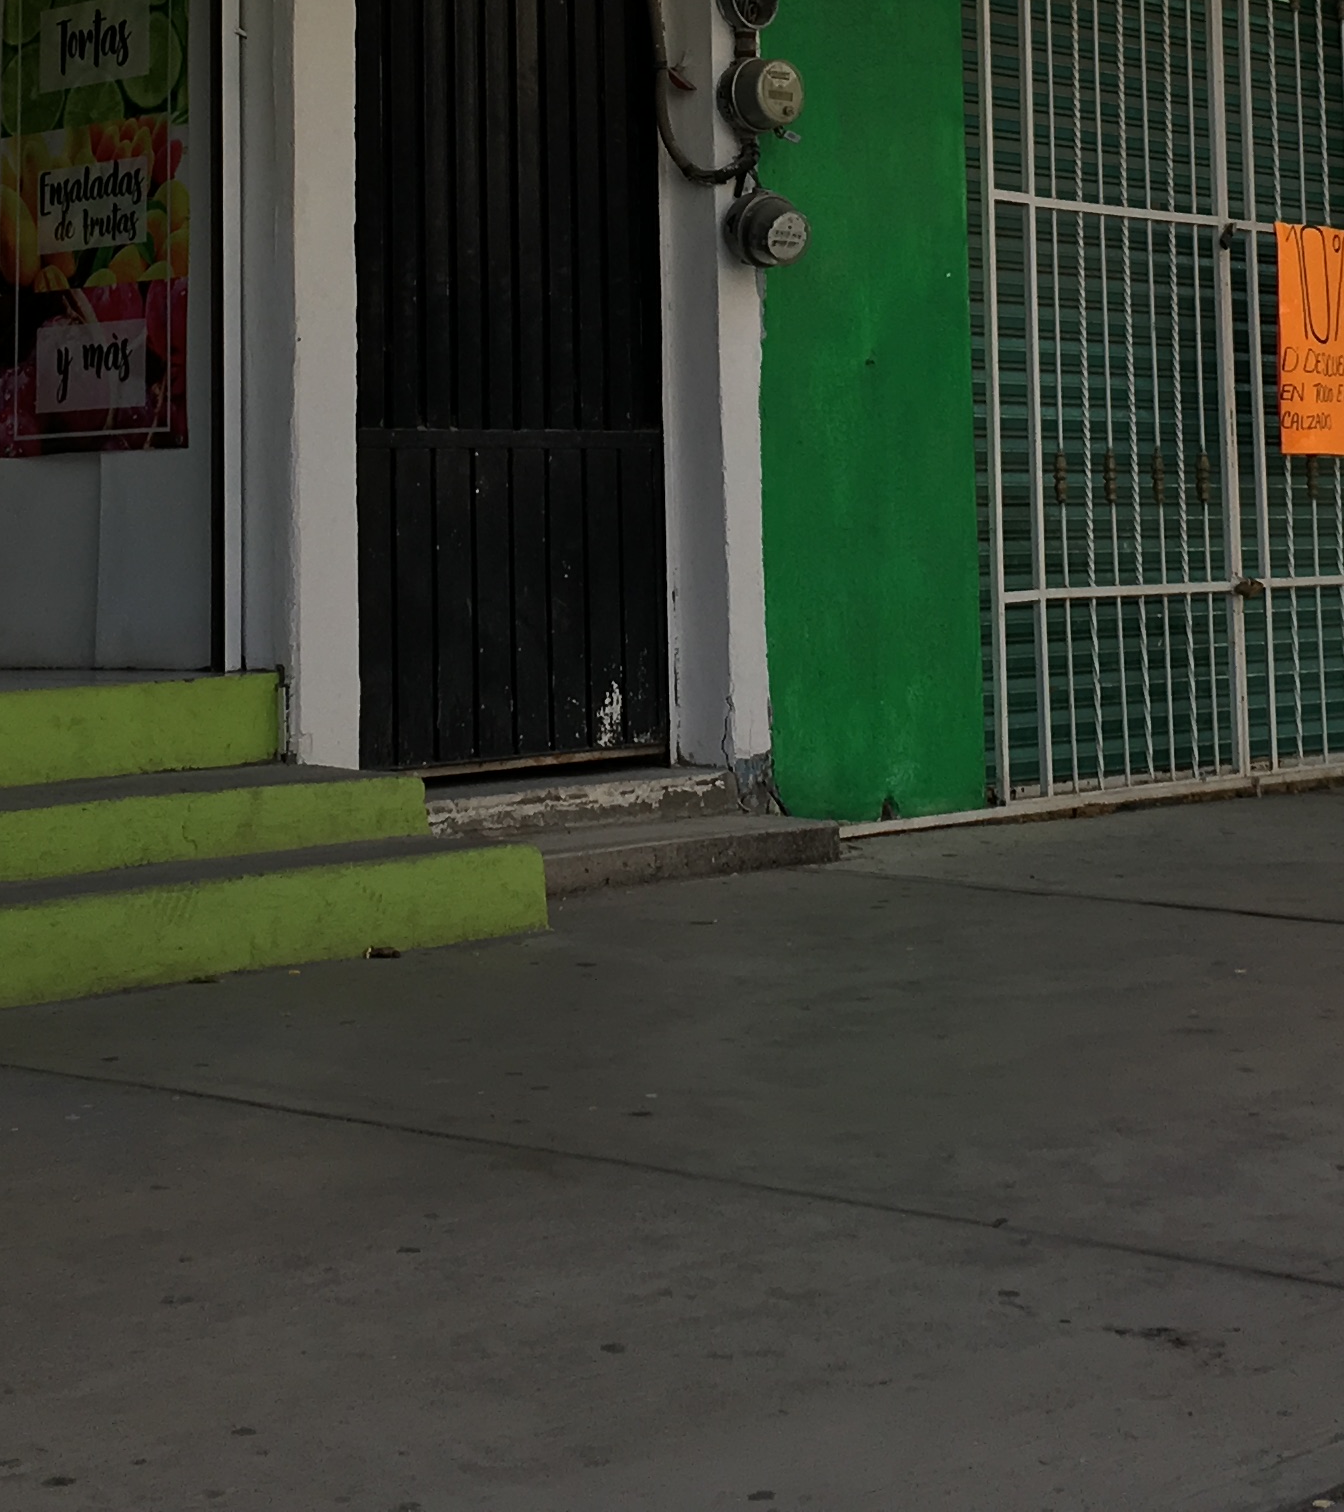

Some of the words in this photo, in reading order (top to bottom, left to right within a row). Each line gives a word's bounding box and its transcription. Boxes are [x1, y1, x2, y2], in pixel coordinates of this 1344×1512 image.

[57, 8, 134, 76] Tortas
[40, 159, 145, 216] Ensaladas
[55, 210, 75, 243] de
[82, 205, 138, 246] frutas
[56, 348, 72, 404] y
[1279, 382, 1305, 402] EN
[1281, 410, 1333, 431] CALZADO
